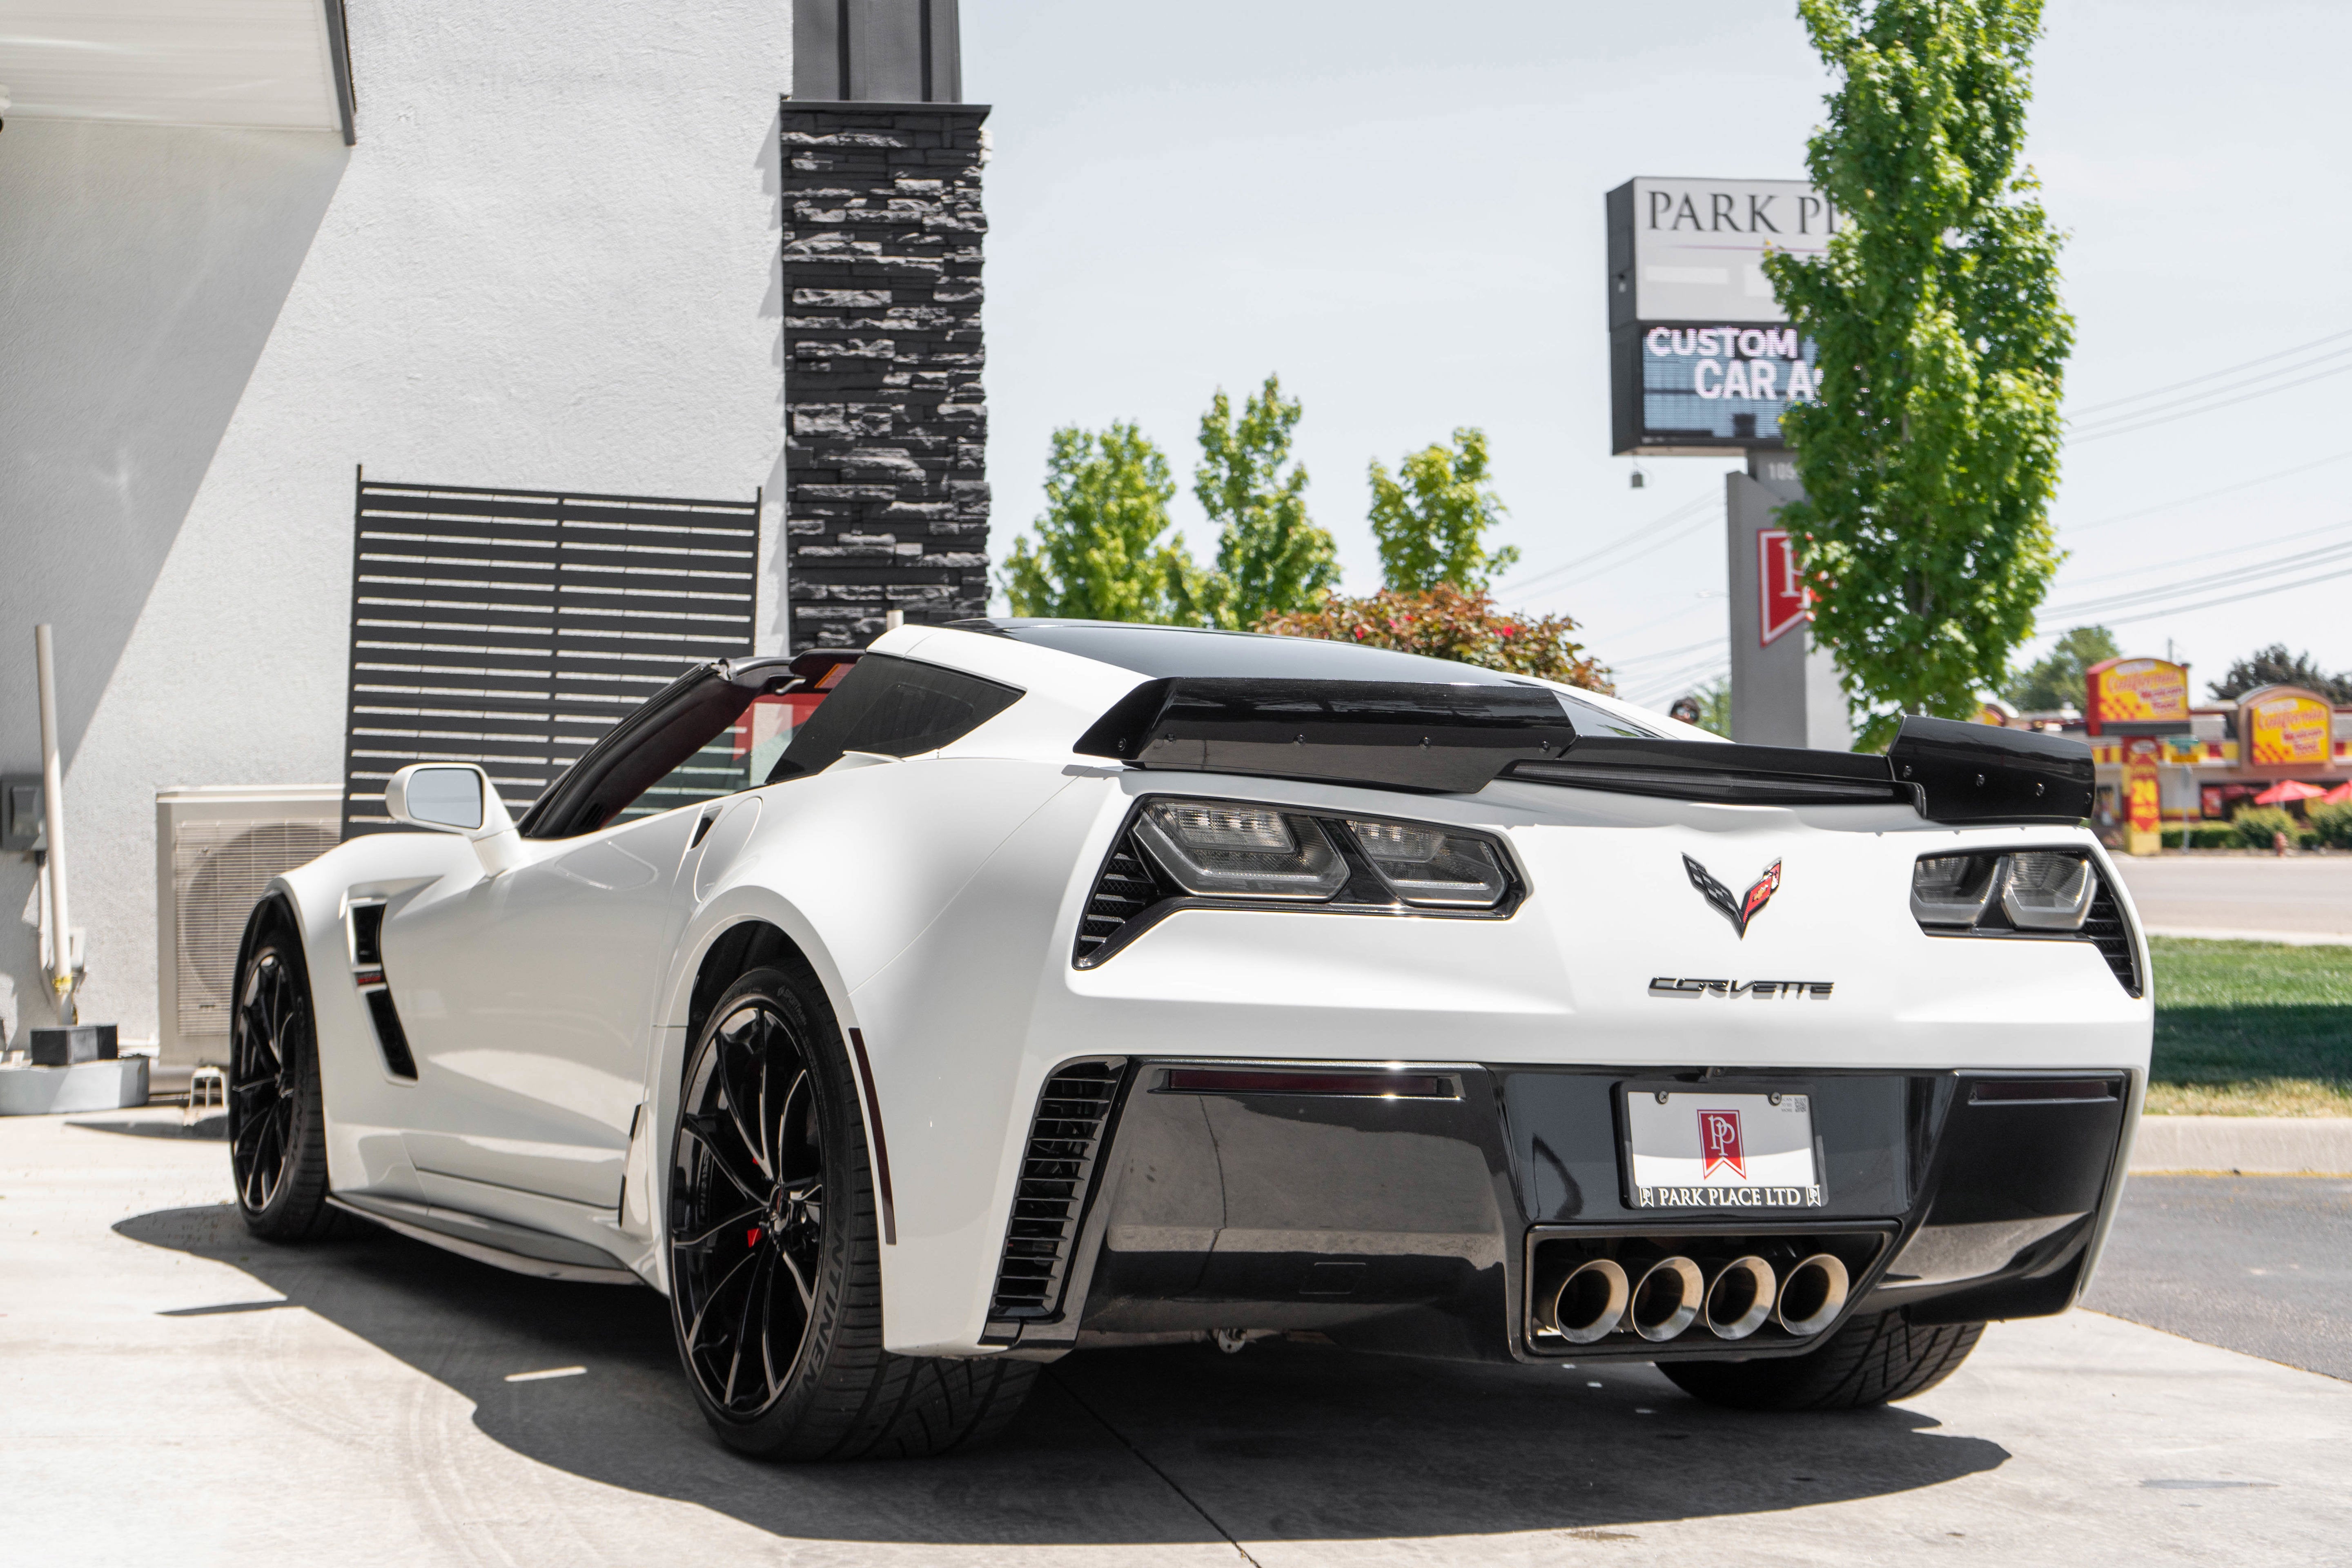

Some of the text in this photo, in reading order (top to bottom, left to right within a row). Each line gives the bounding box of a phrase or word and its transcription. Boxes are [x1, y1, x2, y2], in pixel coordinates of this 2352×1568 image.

[1647, 191, 1783, 234] PARK
[1647, 327, 1797, 359] CUSTOM
[1694, 358, 1777, 401] CAR
[2131, 779, 2157, 805] 24
[1649, 976, 1834, 994] CORVETTE
[1659, 1188, 1802, 1206] PARK PLACE LTD
